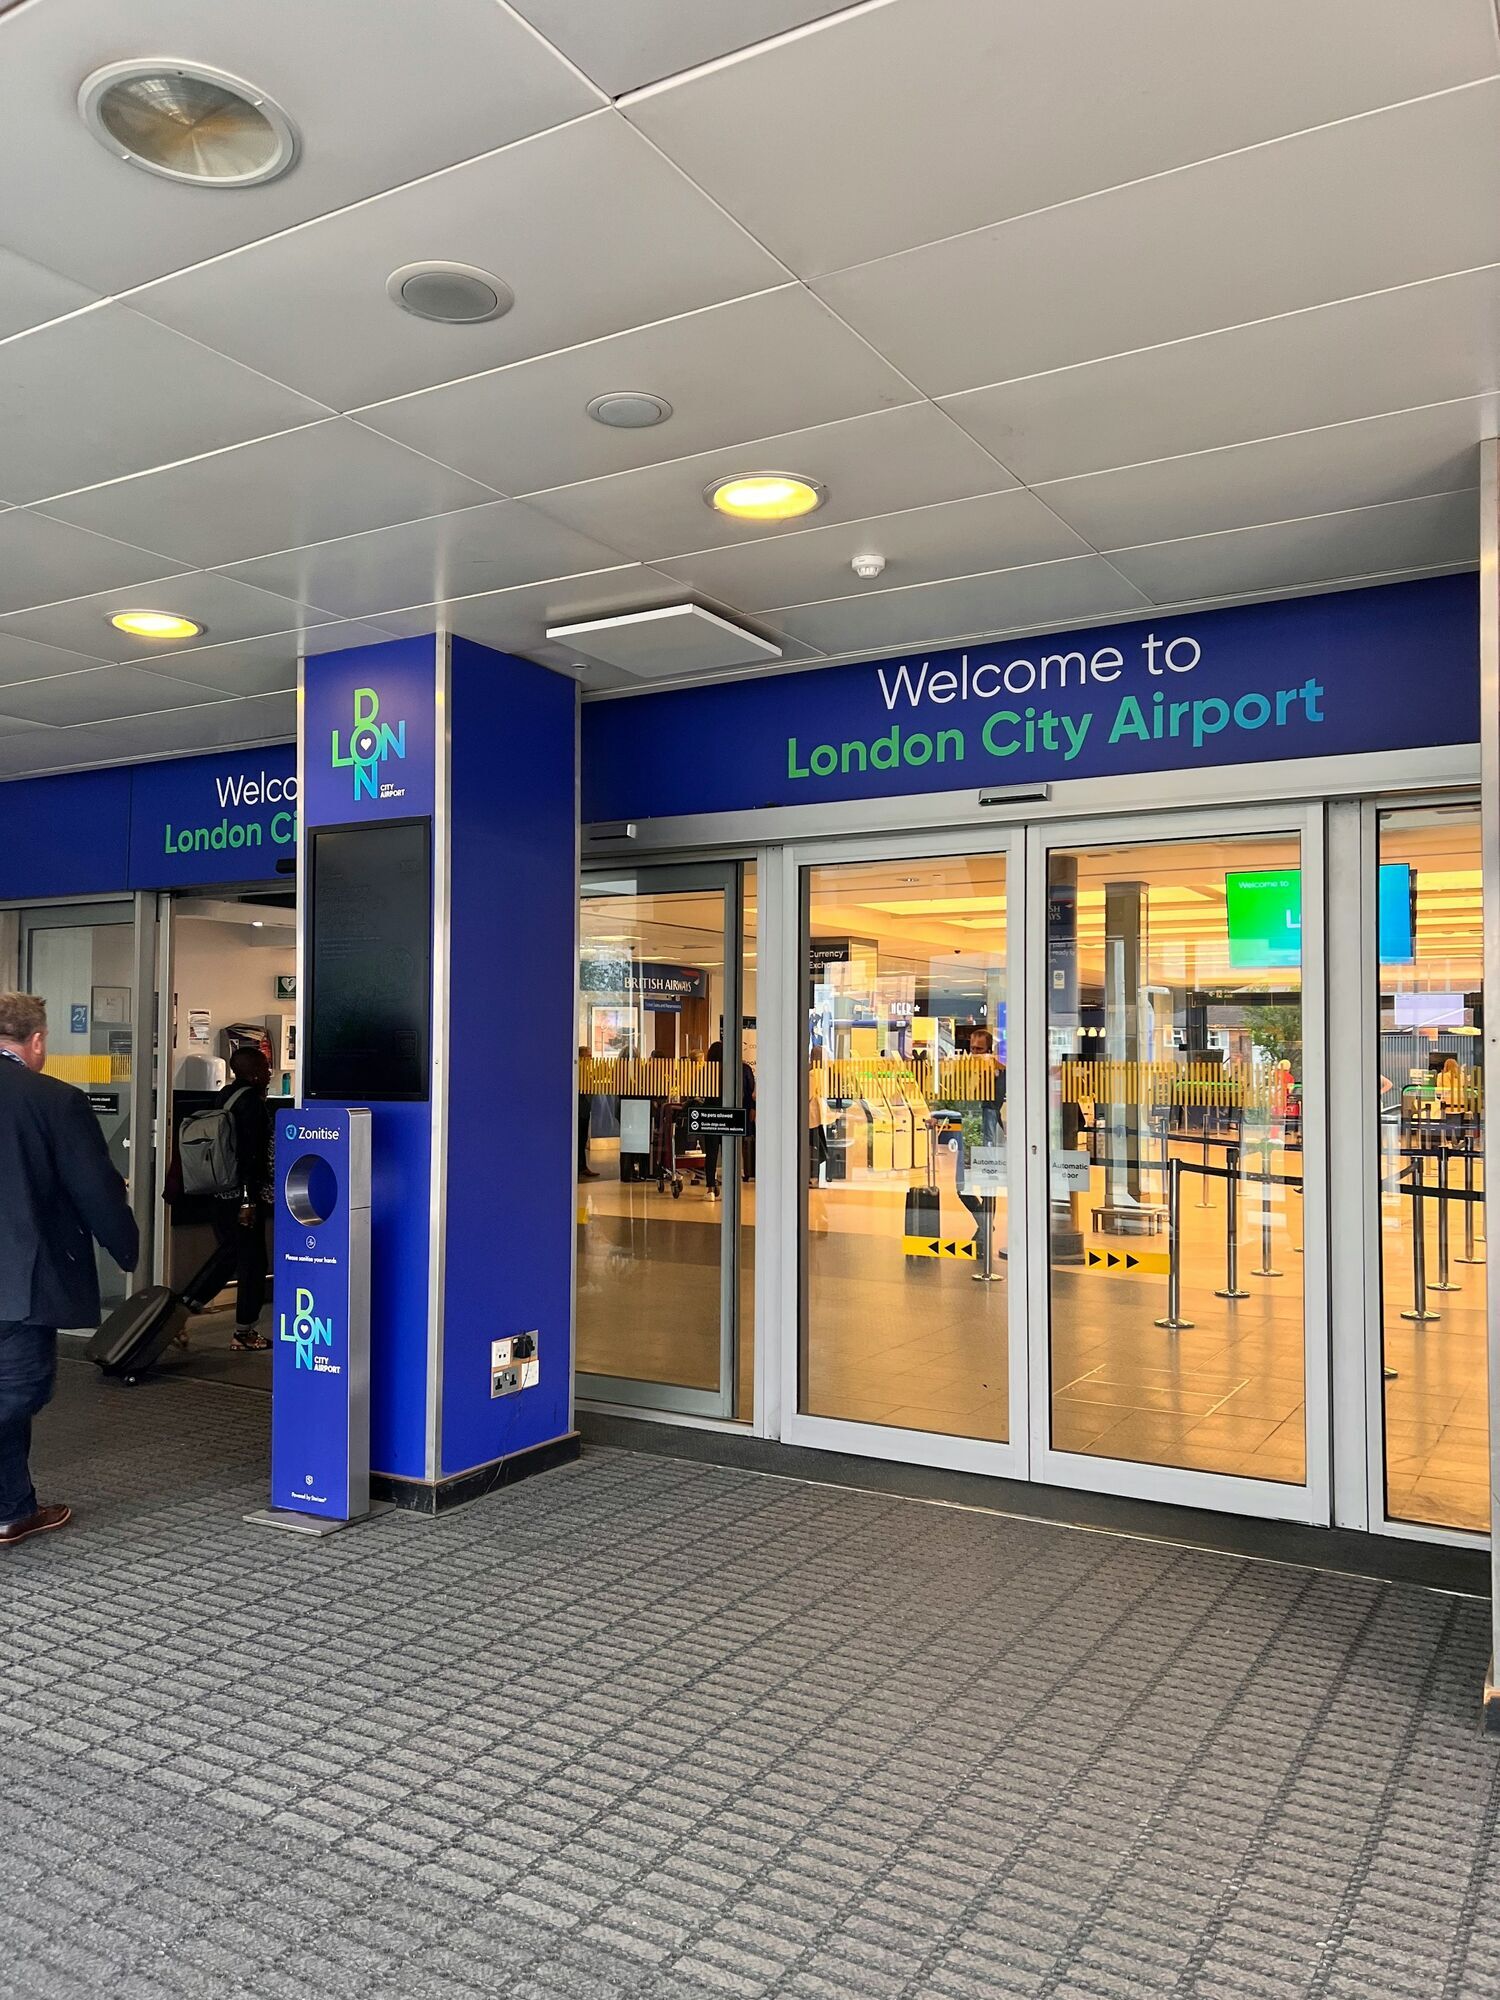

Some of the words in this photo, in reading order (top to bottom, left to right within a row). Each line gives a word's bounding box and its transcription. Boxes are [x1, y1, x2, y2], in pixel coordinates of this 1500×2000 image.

[877, 646, 1122, 710] Welcome
[1141, 632, 1201, 676] to
[787, 725, 965, 779] London
[981, 707, 1092, 761] City
[1108, 677, 1324, 748] Airport
[216, 770, 297, 808] Welco
[380, 783, 394, 791] CITY
[380, 789, 406, 798] AIRPORT
[165, 818, 262, 854] London
[270, 811, 297, 844] Ci
[1238, 881, 1278, 889] Welcome
[1280, 880, 1290, 888] to
[809, 950, 844, 959] Currency
[624, 977, 664, 990] BRITISH
[664, 979, 692, 992] AIRWAYS
[299, 1126, 340, 1140] Zonitise
[973, 1158, 1006, 1166] Automatic
[1052, 1162, 1088, 1171] Automatic
[1062, 1171, 1079, 1179] door
[285, 1253, 298, 1261] Please
[323, 1256, 337, 1264] hands
[314, 1356, 329, 1365] CITY
[314, 1364, 341, 1374] AIRPORT
